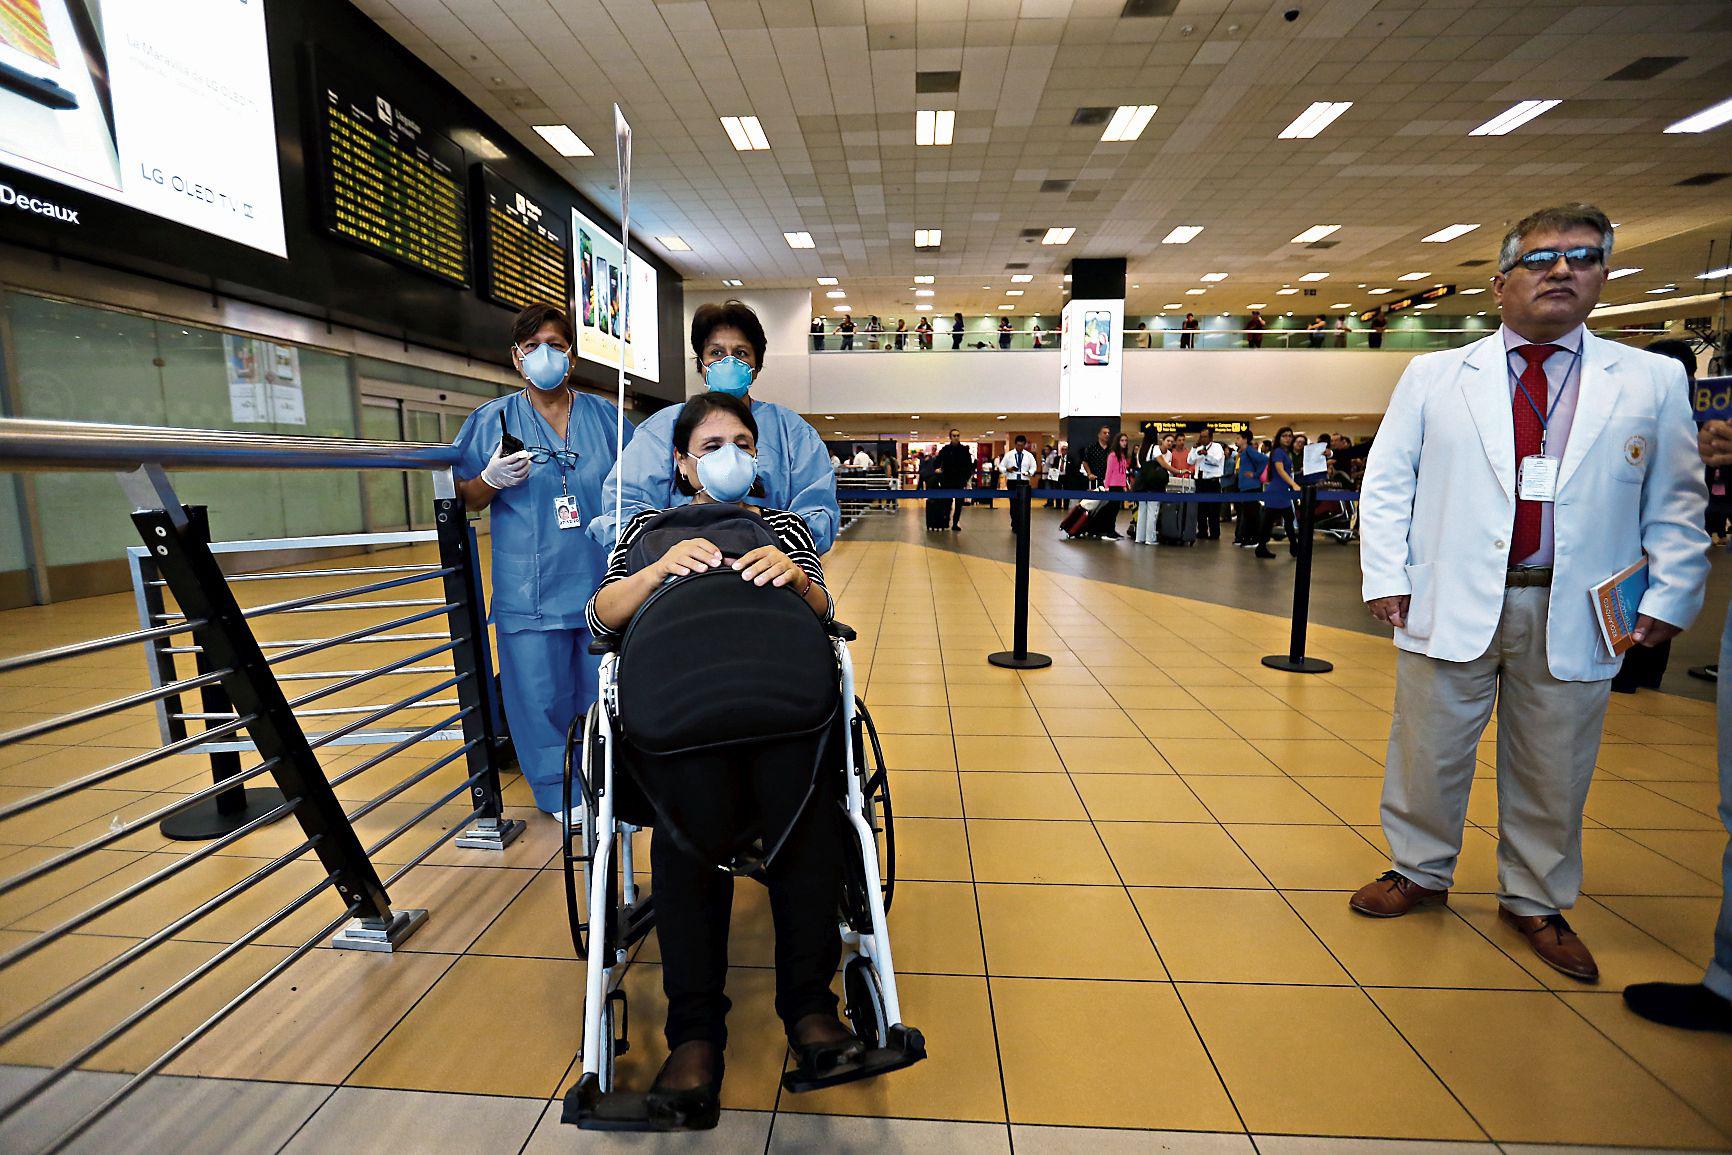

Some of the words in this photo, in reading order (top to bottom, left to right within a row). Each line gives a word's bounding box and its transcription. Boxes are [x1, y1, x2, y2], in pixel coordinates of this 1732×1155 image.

[141, 162, 164, 185] LG
[171, 175, 215, 204] OLED
[0, 184, 81, 225] Decaux
